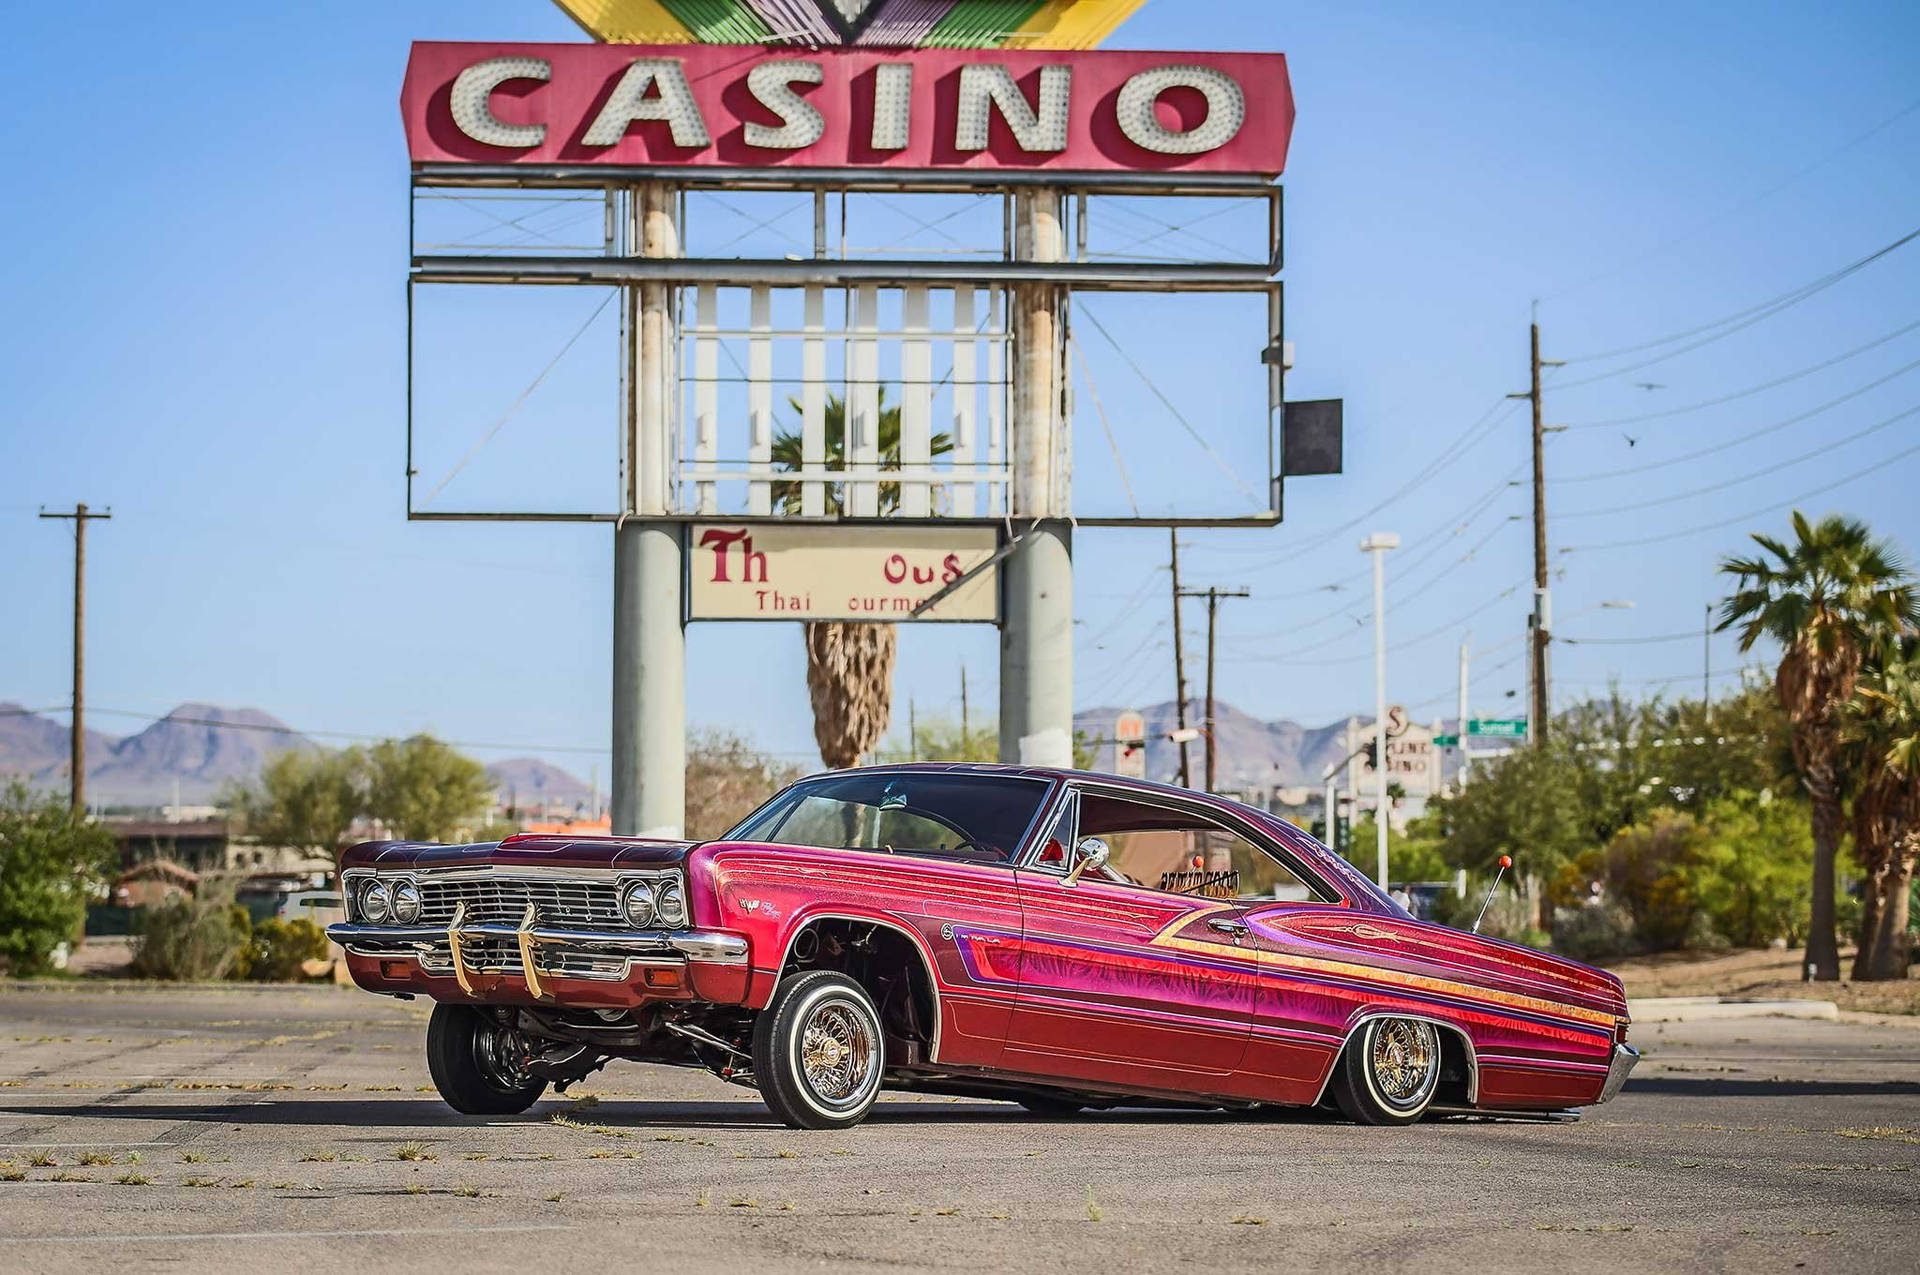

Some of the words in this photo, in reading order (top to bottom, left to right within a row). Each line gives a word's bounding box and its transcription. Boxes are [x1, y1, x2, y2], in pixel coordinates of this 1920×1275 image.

[449, 57, 1246, 156] CASINO
[700, 527, 769, 583] Th
[756, 590, 811, 611] Thai
[848, 595, 936, 612] ourme
